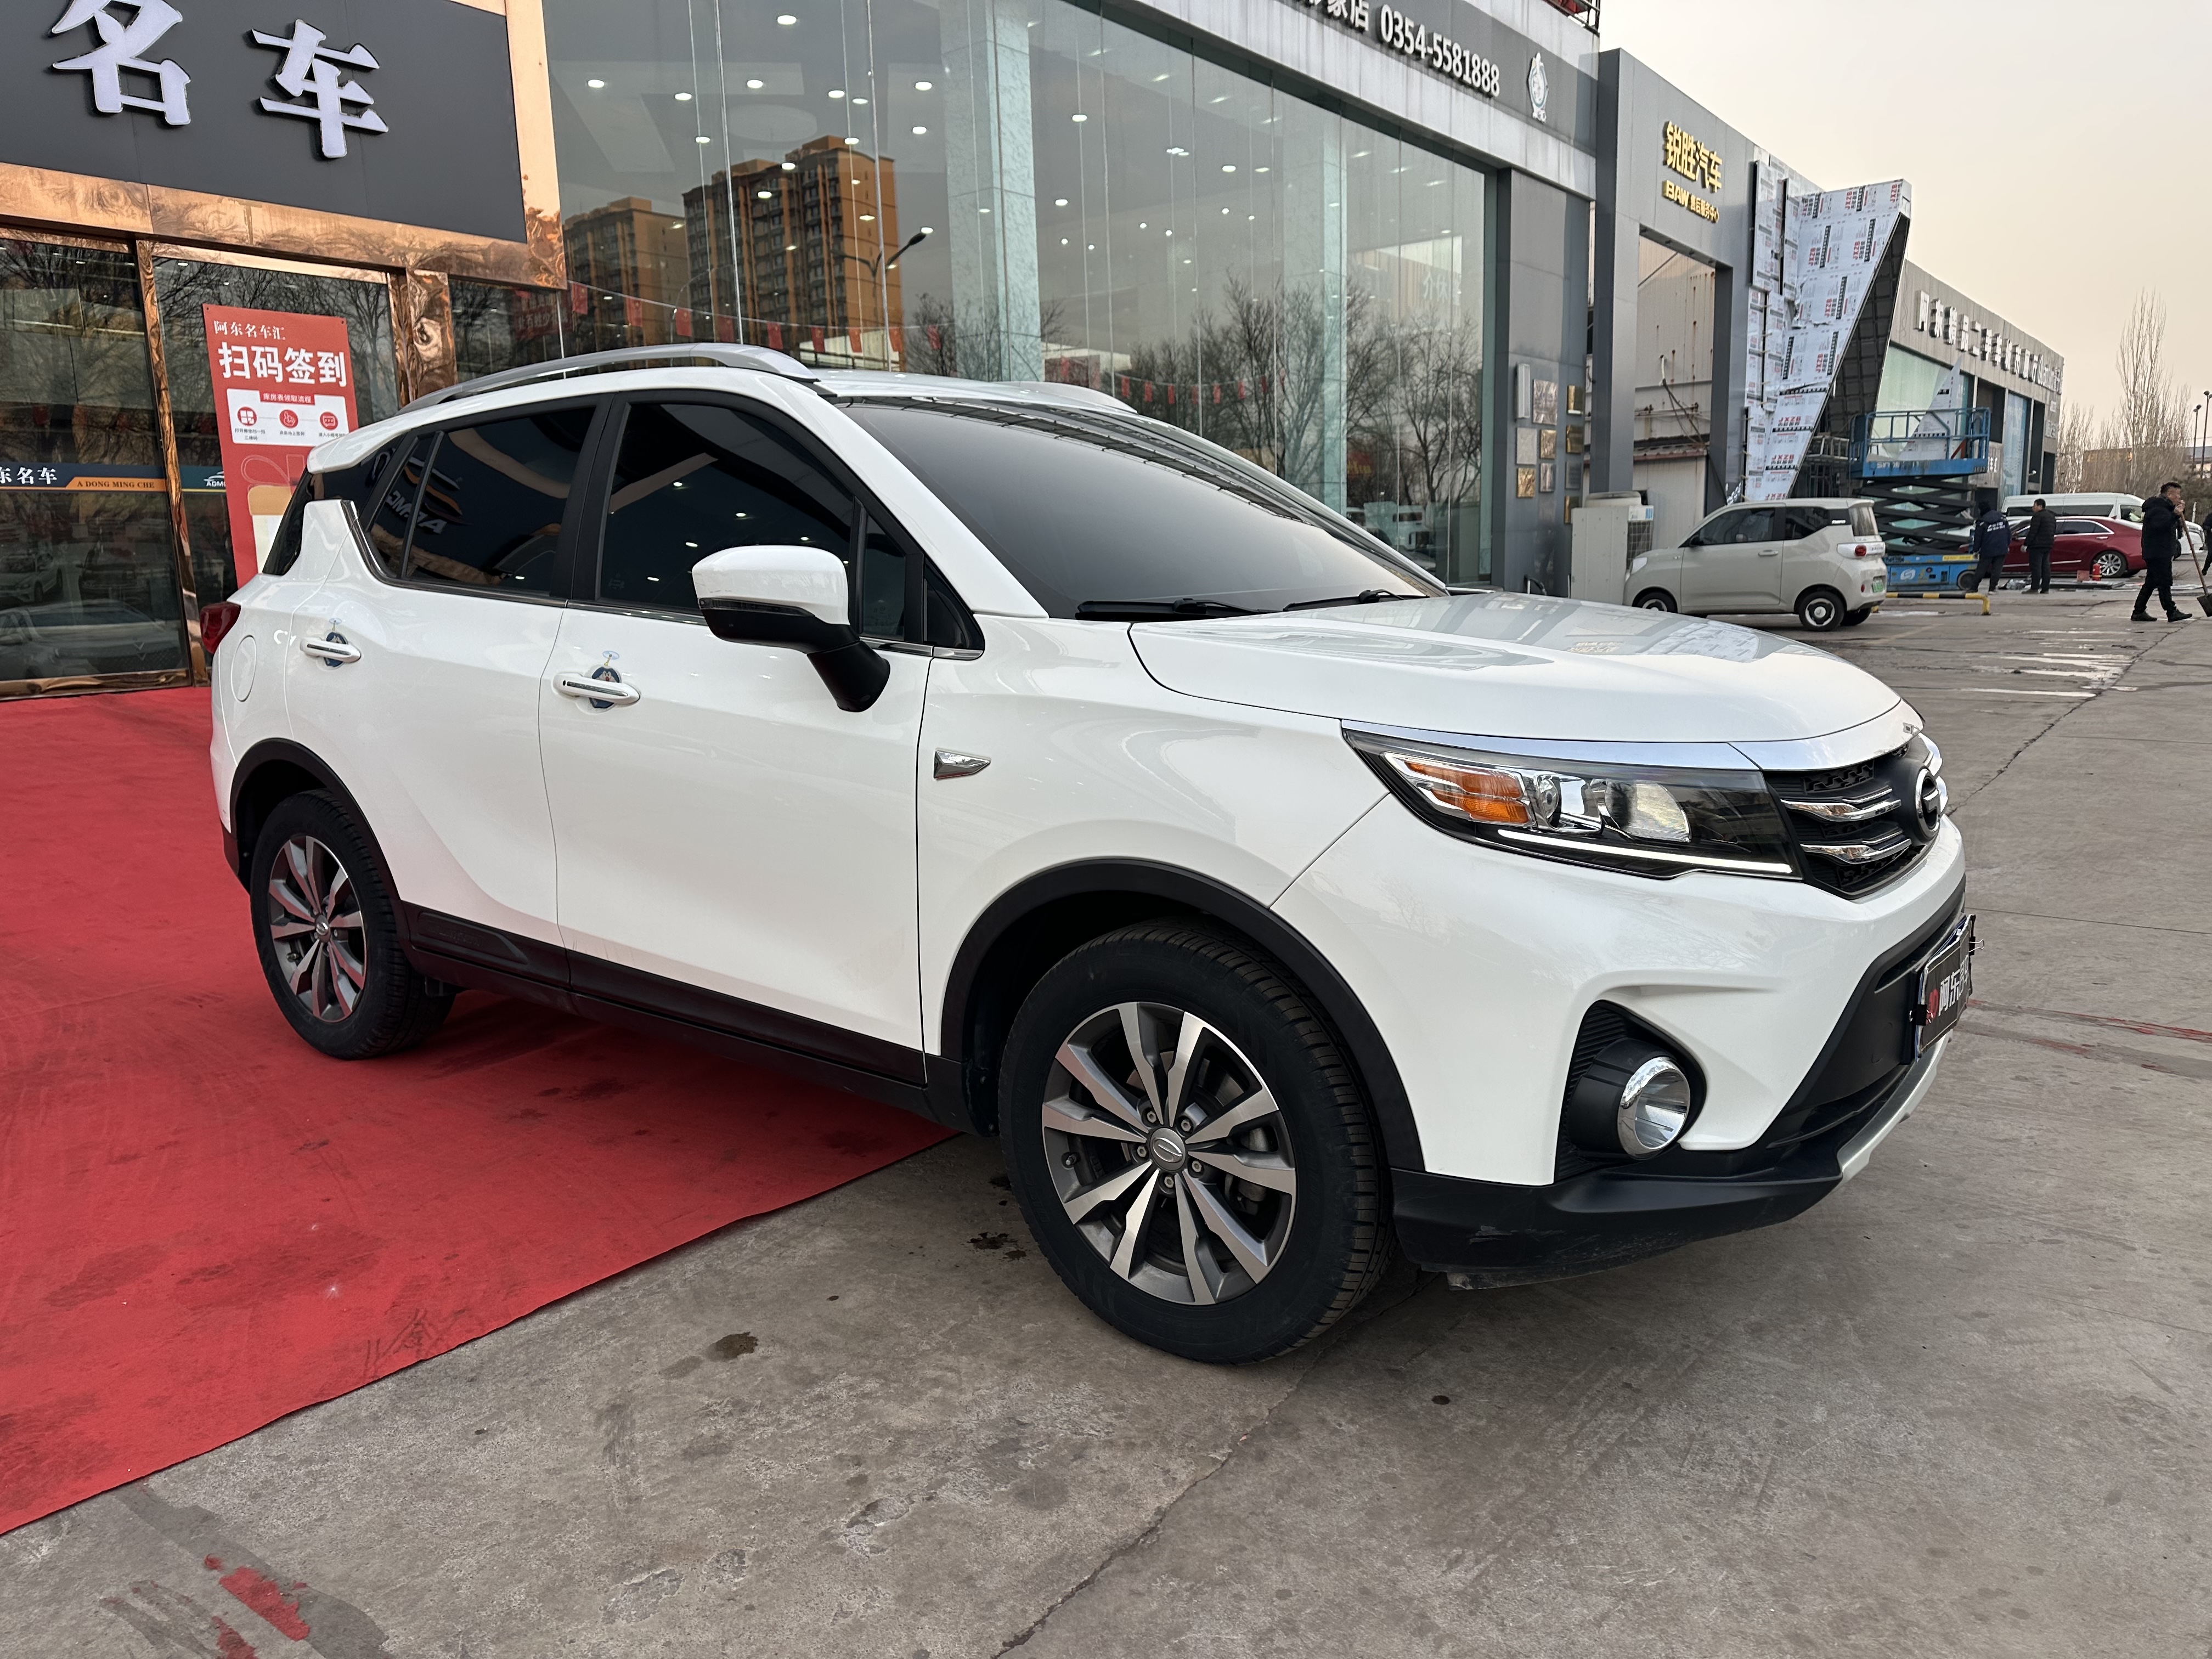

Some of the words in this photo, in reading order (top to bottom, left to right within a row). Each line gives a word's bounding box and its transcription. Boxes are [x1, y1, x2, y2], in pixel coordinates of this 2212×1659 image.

[1380, 4, 1500, 97] 0354-5581888
[1666, 120, 1723, 193] 锐胜汽车
[1665, 179, 1690, 207] BAW
[213, 320, 286, 340] 阿东名车汇
[218, 341, 347, 387] 扫码签到
